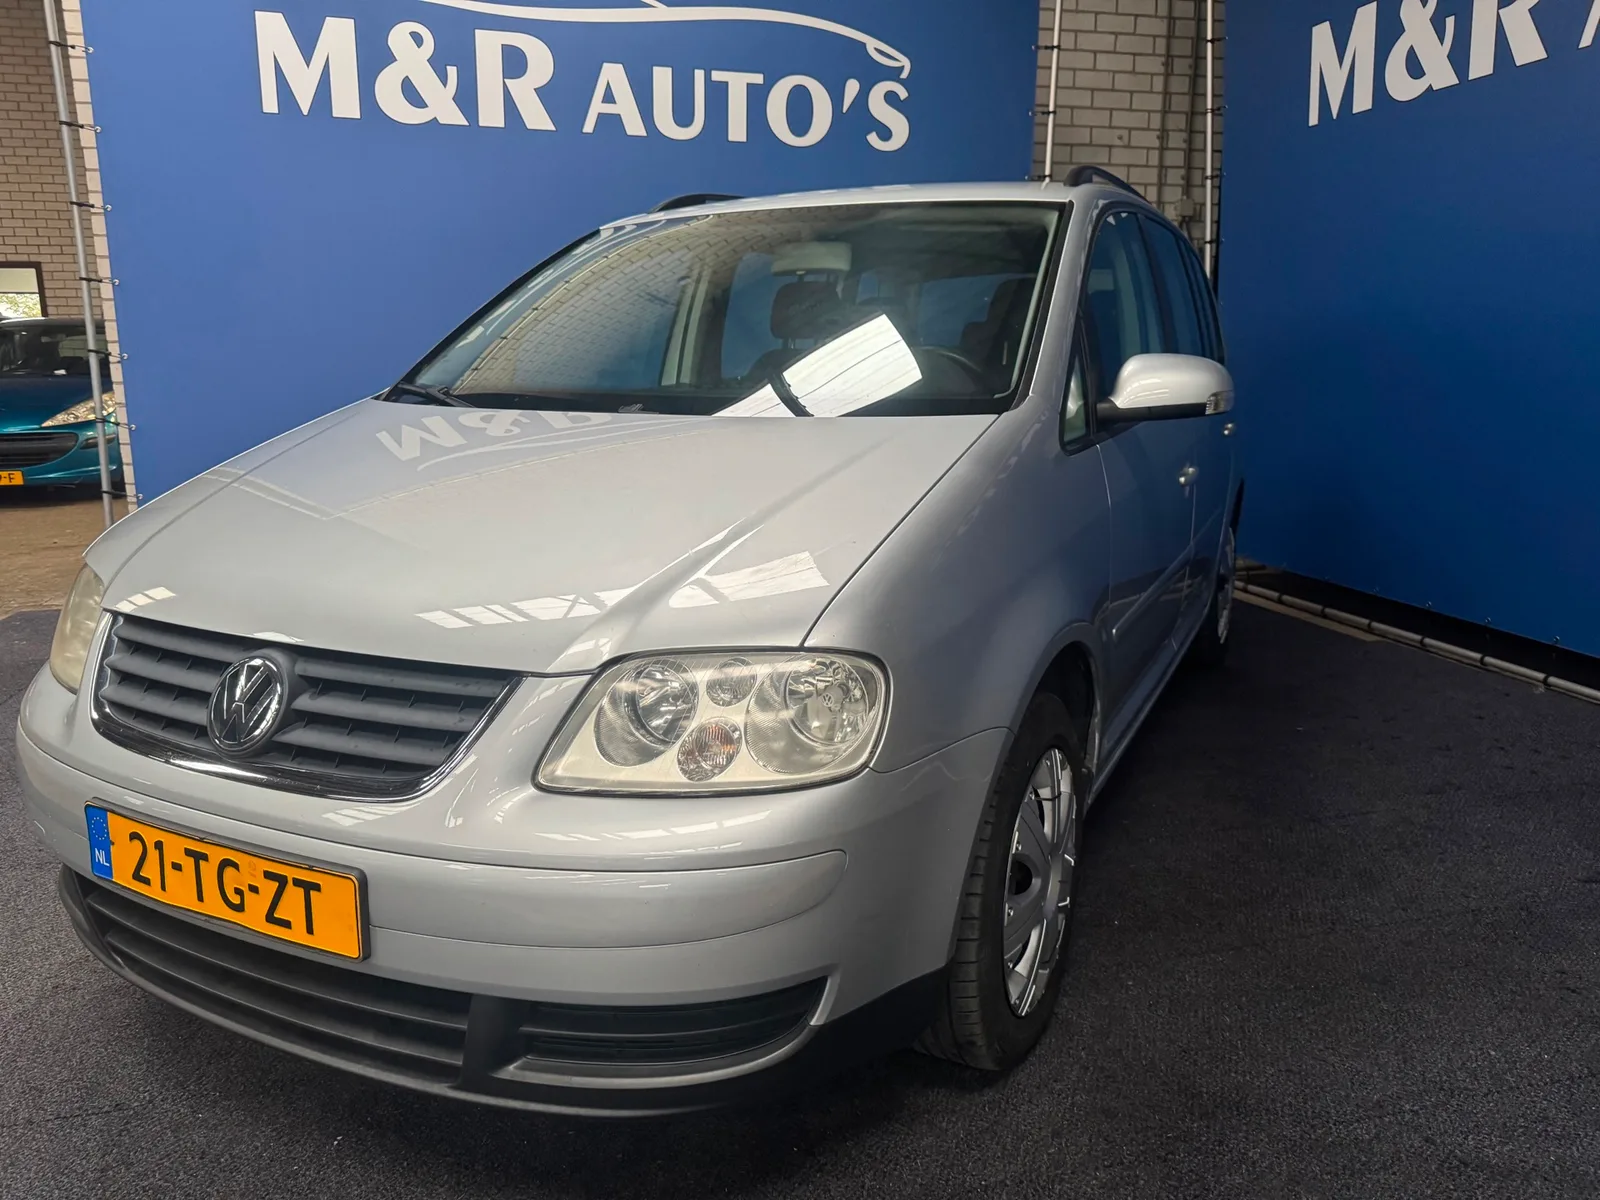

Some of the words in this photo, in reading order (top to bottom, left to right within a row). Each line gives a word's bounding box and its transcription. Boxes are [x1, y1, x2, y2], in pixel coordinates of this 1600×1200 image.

[253, 10, 557, 131] M&R
[0, 473, 15, 483] -F
[94, 848, 110, 867] NL
[128, 831, 322, 936] 21-TG-ZT
